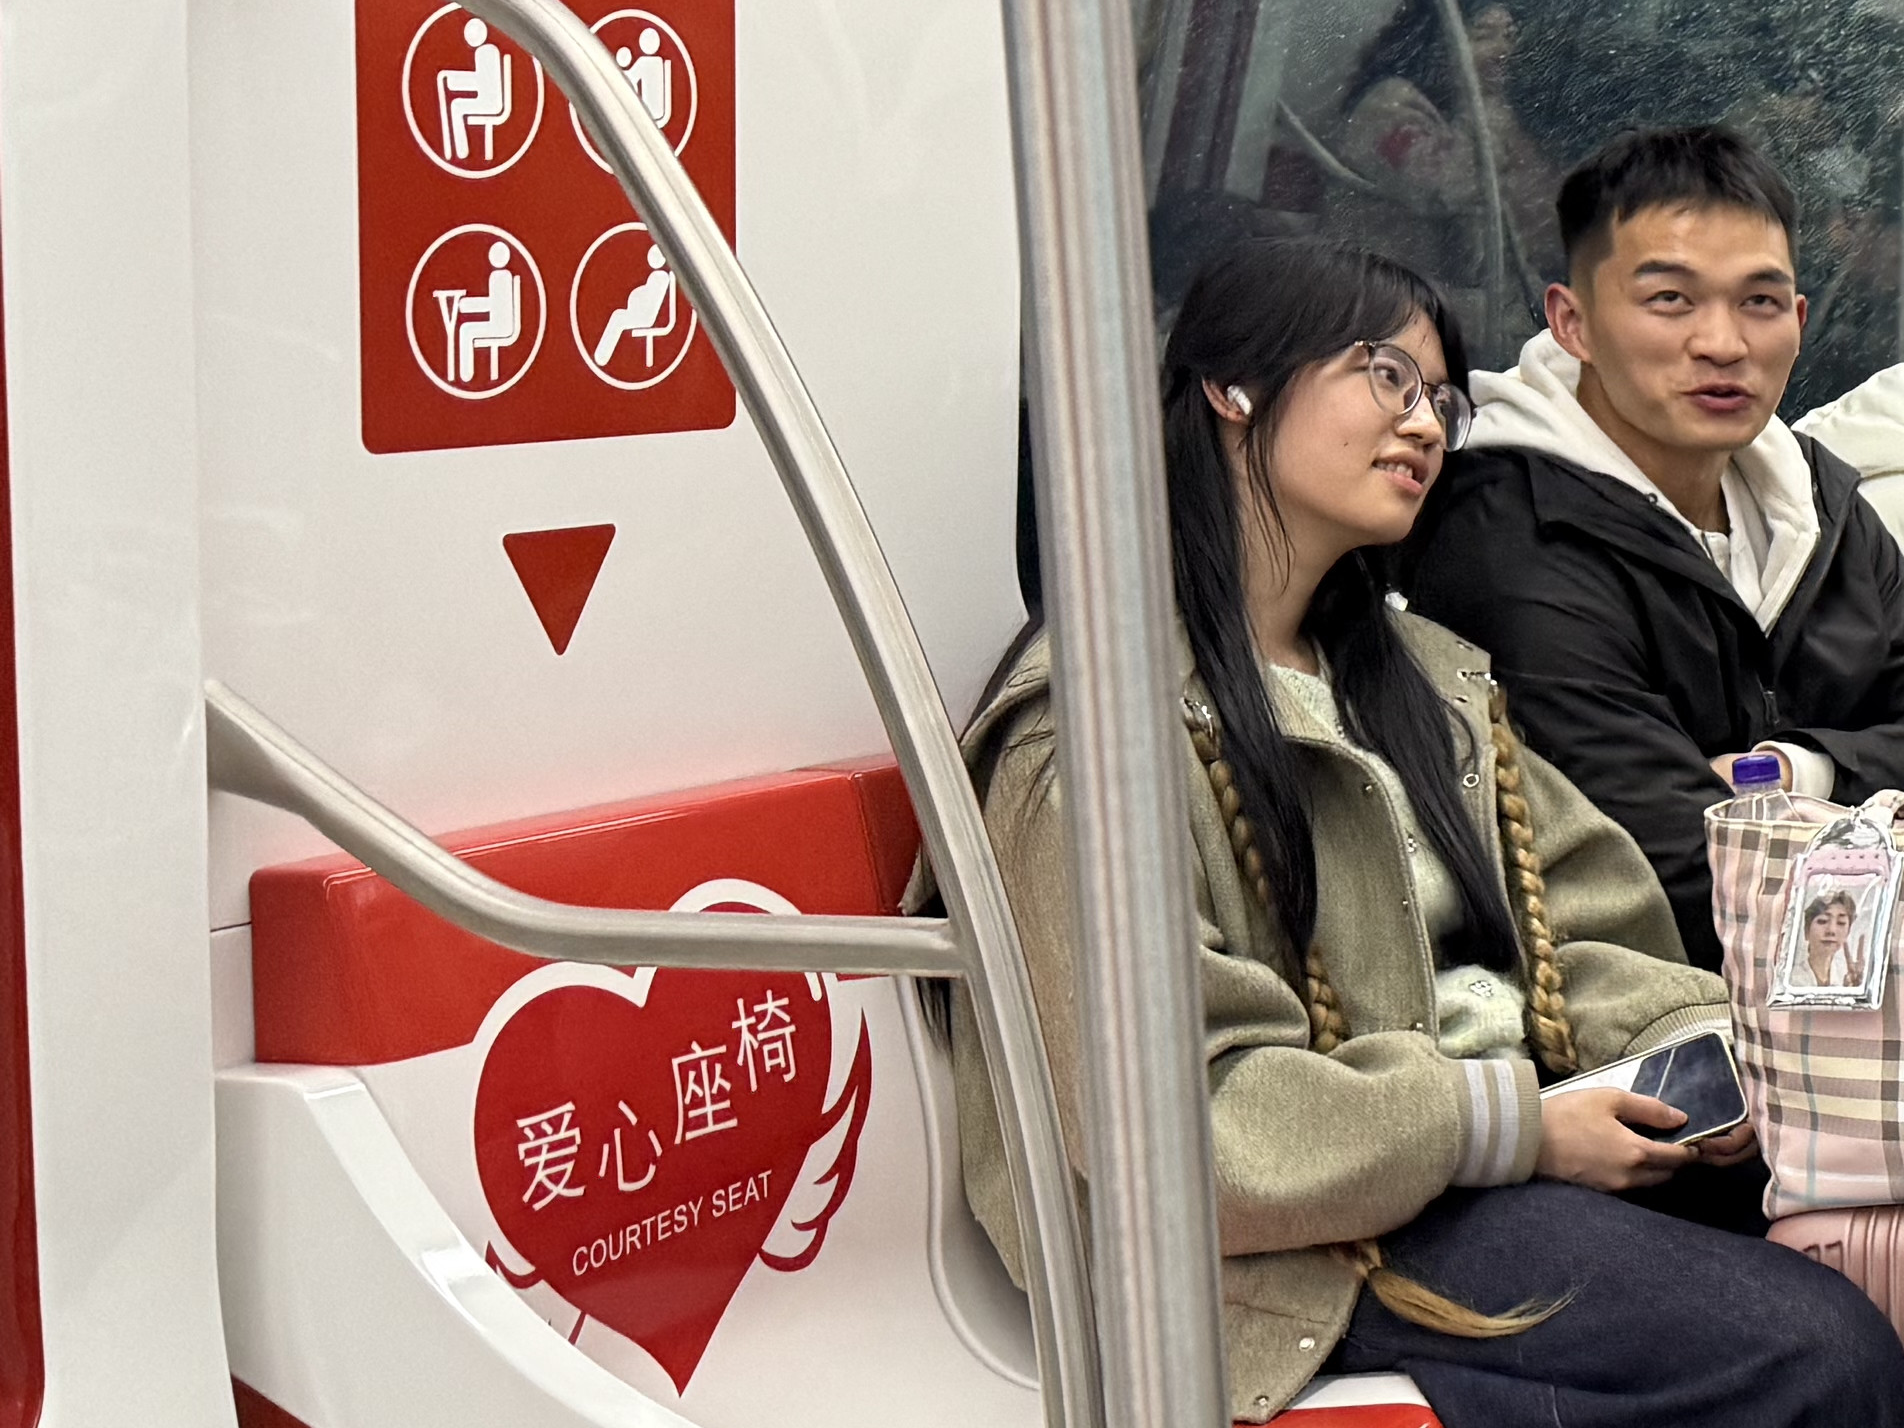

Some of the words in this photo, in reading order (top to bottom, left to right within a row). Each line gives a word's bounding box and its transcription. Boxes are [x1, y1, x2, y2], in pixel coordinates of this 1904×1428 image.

[515, 988, 797, 1212] 爱心座椅
[571, 1196, 704, 1276] COURTESY
[711, 1169, 773, 1219] SEAT
